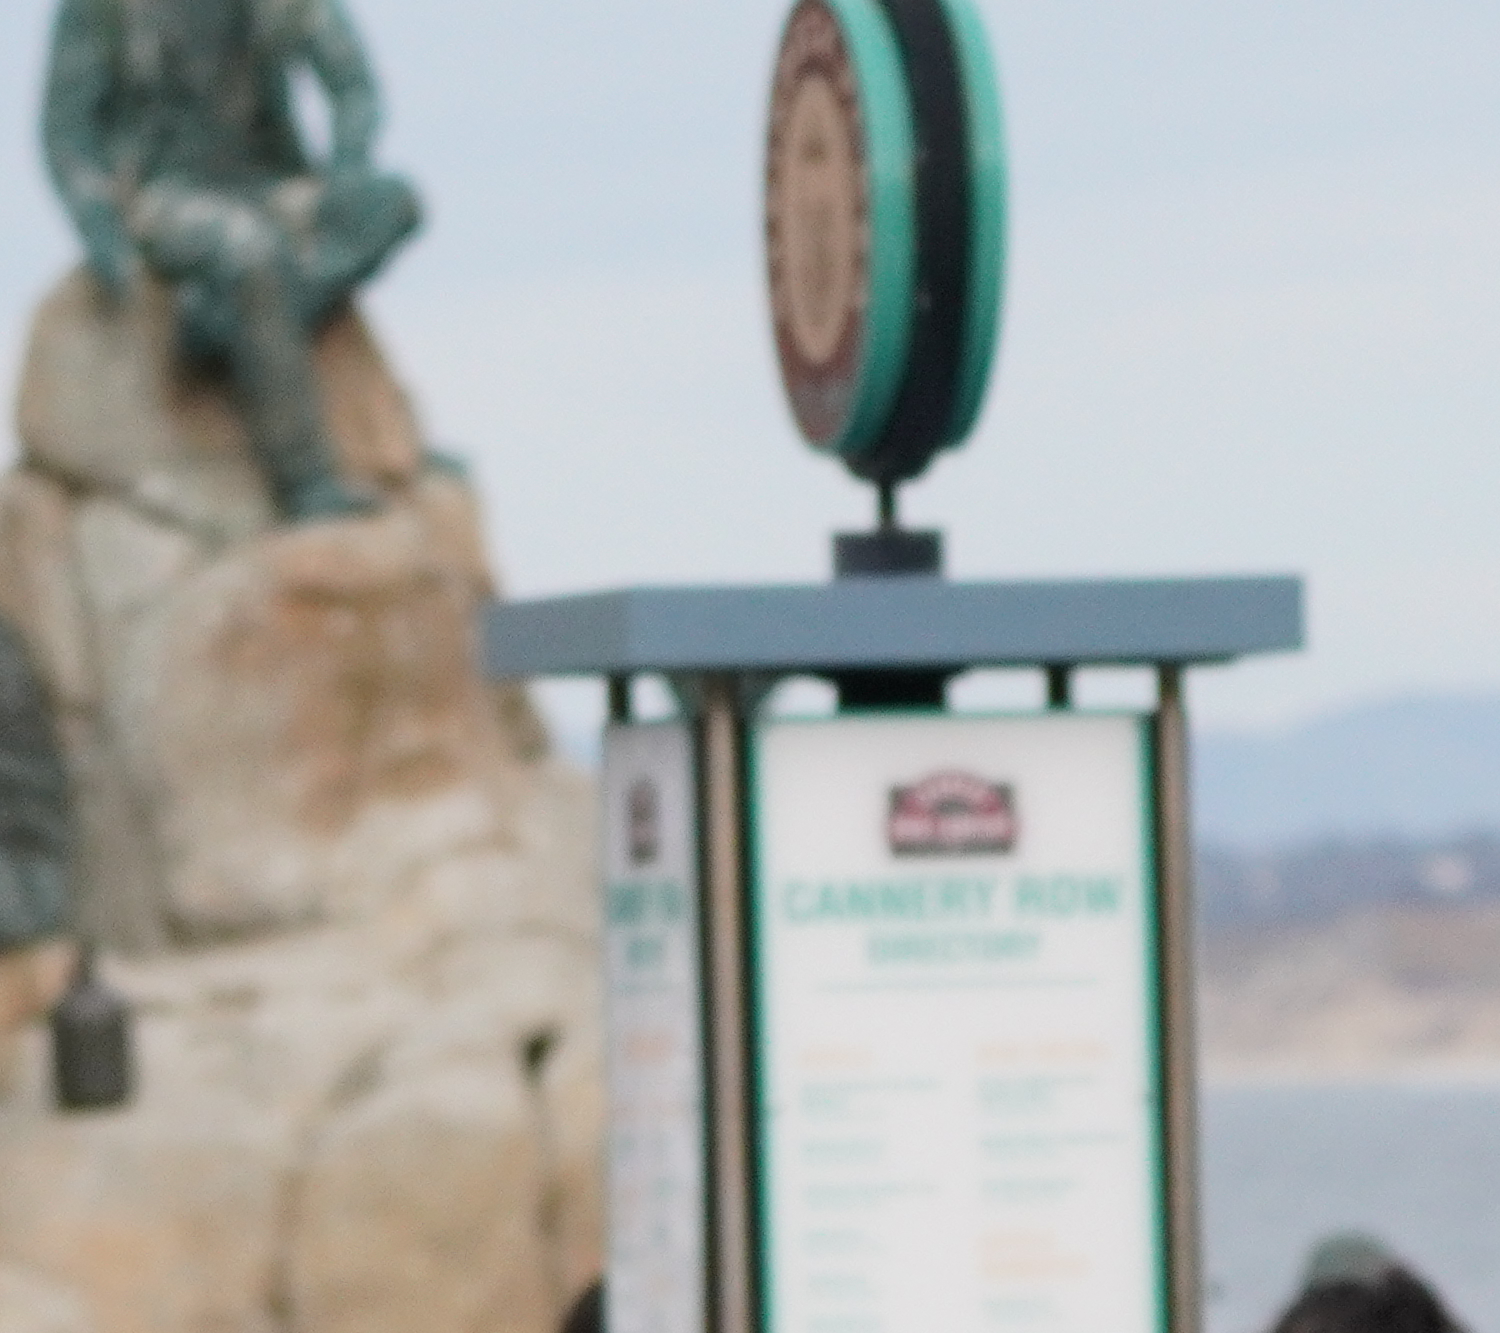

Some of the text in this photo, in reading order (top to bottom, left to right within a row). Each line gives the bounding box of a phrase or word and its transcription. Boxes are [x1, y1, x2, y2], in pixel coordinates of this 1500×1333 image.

[785, 873, 1124, 922] CANNERY ROW
[866, 932, 1042, 966] DIRECTORY
